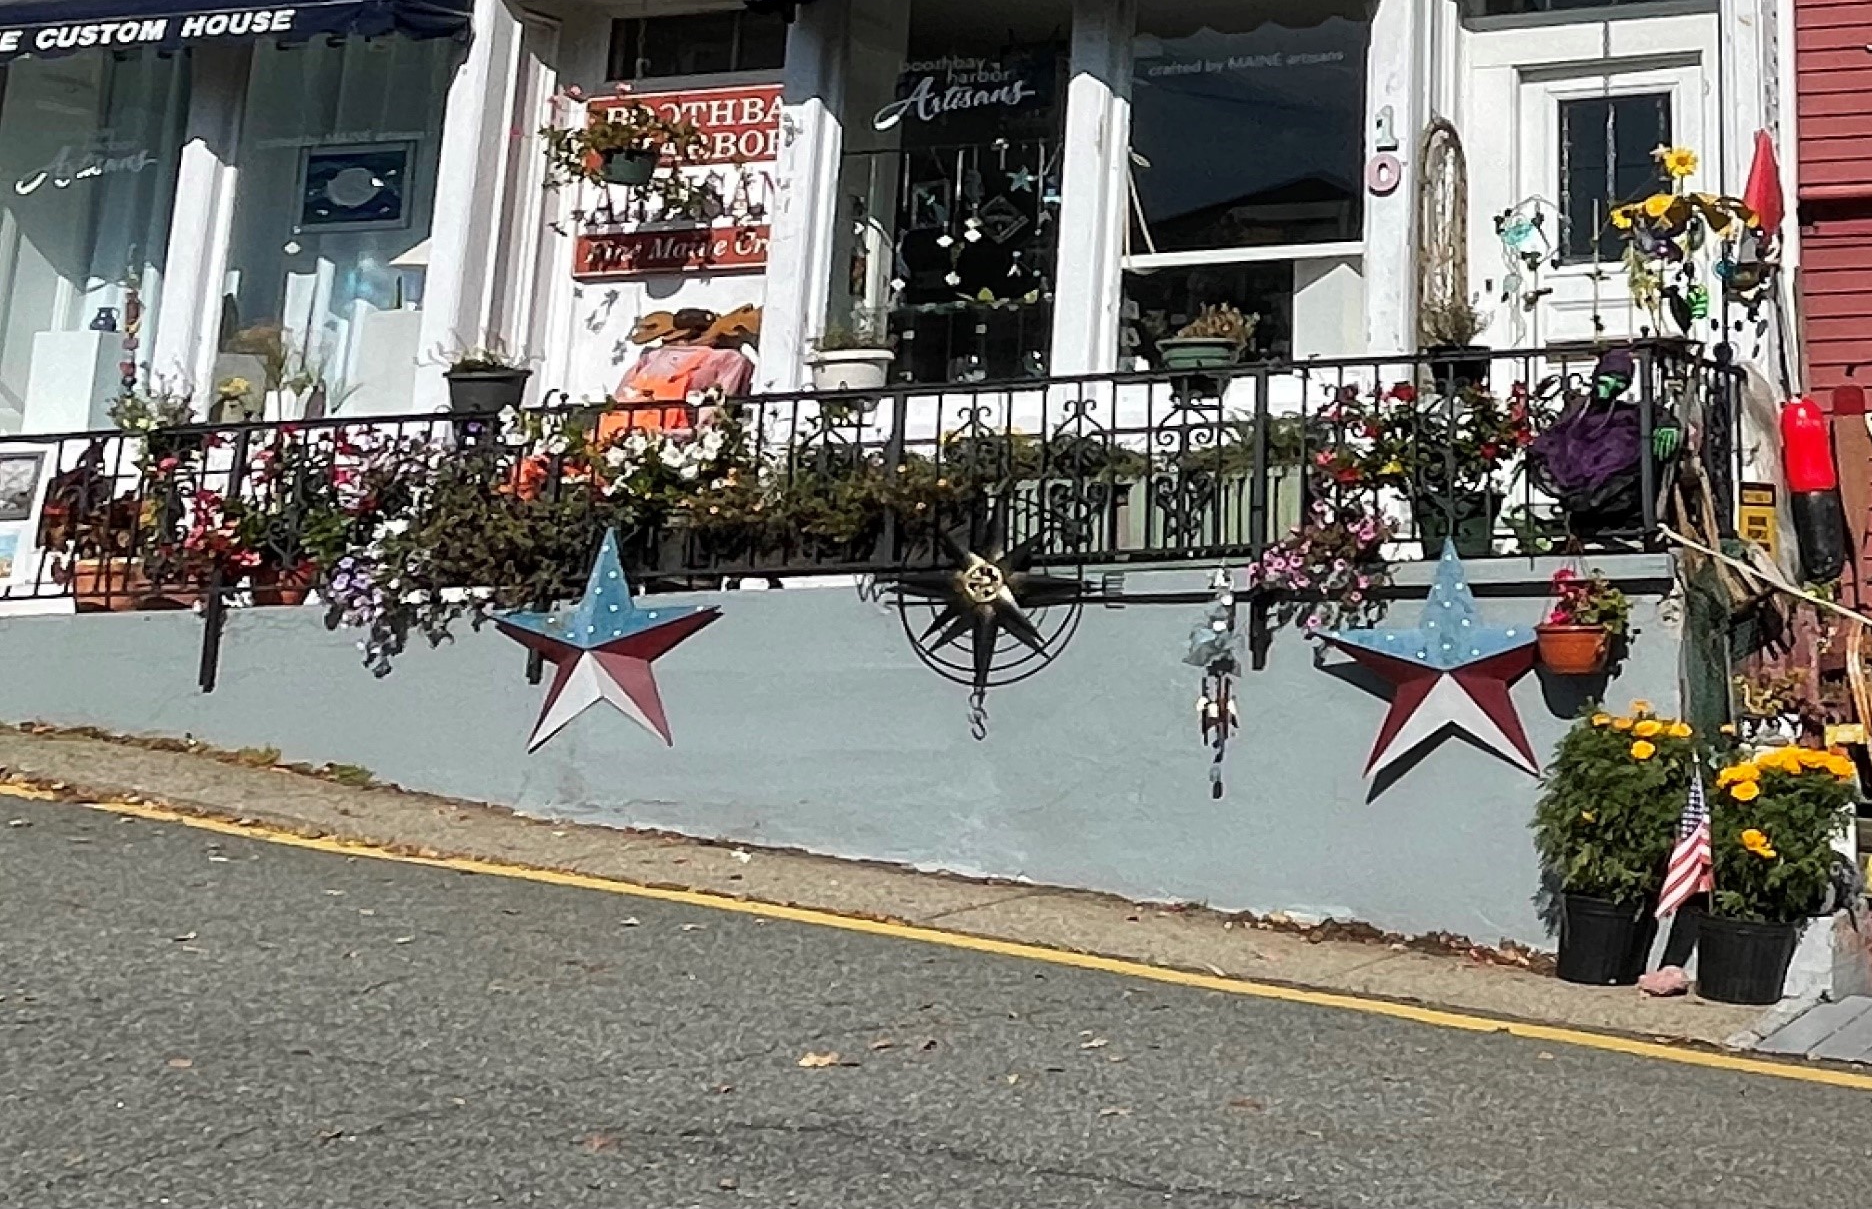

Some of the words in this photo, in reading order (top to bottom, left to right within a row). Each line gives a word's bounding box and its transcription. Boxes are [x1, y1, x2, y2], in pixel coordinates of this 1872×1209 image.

[0, 30, 24, 52] E
[35, 18, 169, 50] CUSTOM
[180, 9, 297, 38] HOUSE
[873, 76, 1036, 131] Artisans
